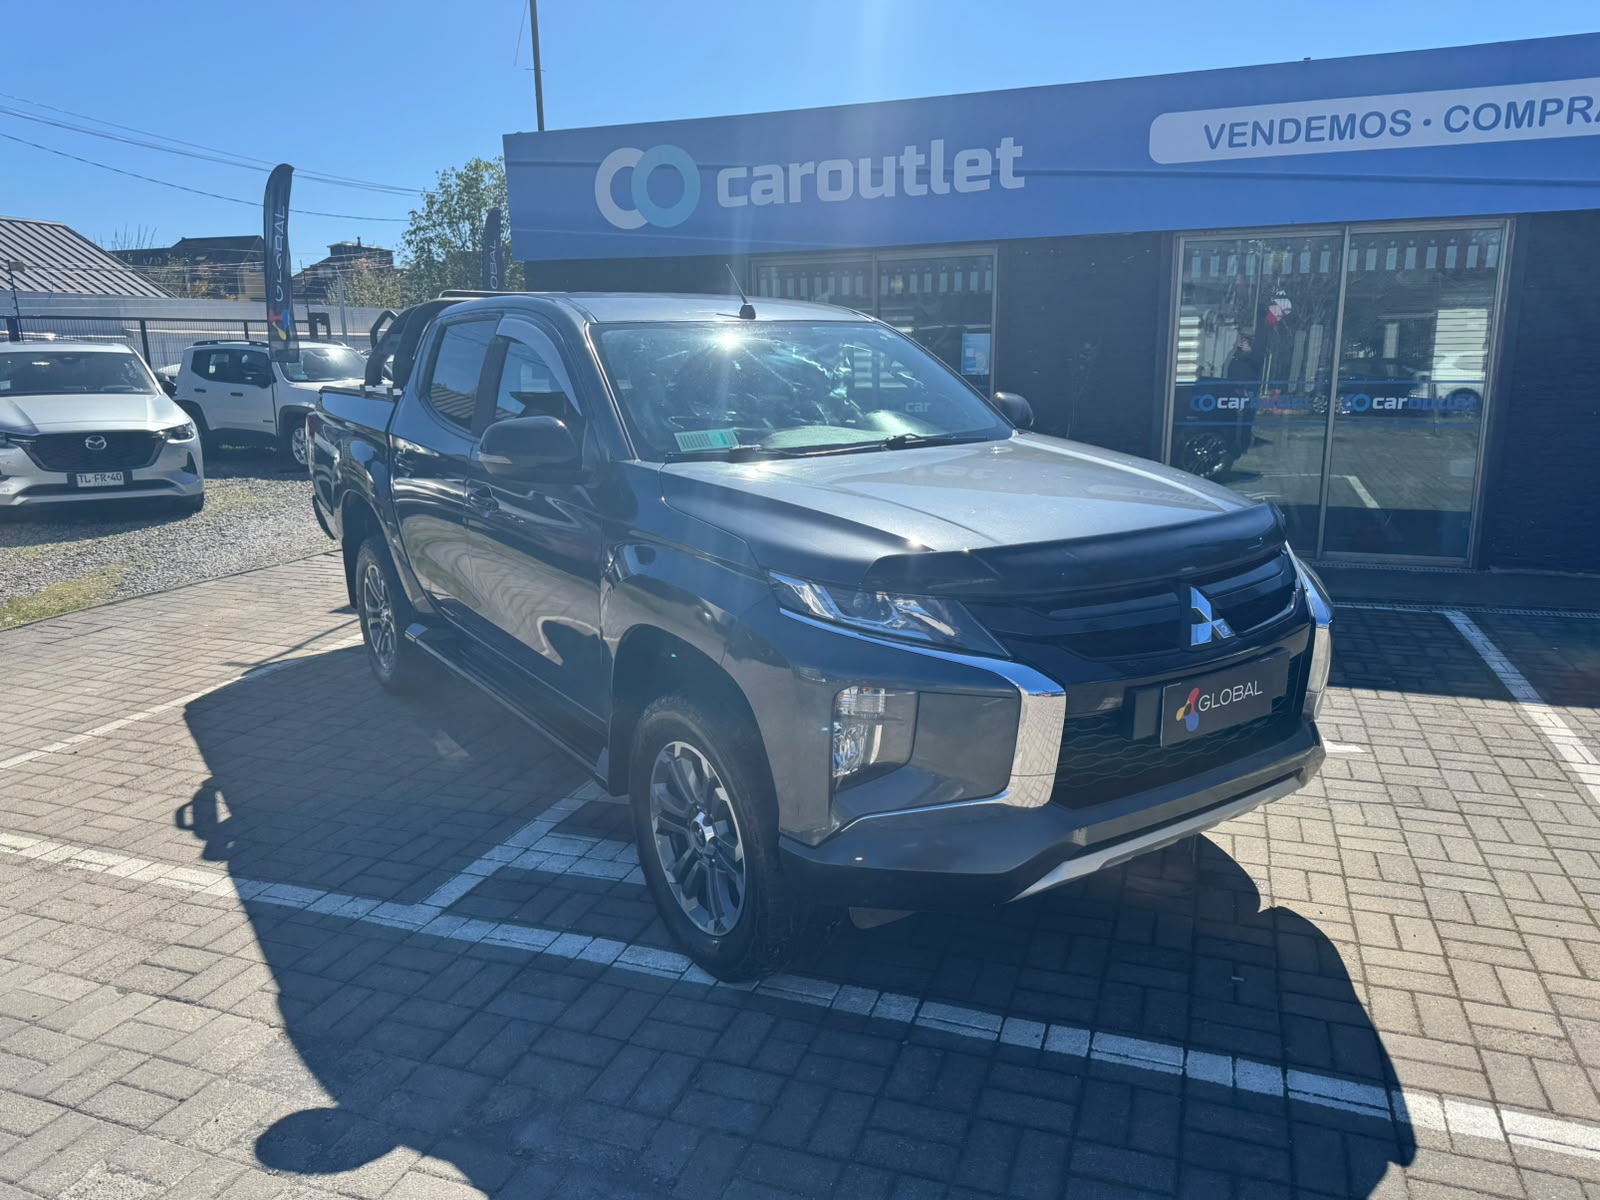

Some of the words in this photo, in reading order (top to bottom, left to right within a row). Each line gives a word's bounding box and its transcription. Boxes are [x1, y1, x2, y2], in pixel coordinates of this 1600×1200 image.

[1203, 108, 1412, 150] VENDEMOS
[1443, 95, 1600, 132] COMPR
[717, 137, 1025, 208] caroutlet
[490, 240, 498, 289] OBAL
[1198, 680, 1263, 712] GLOBAL
